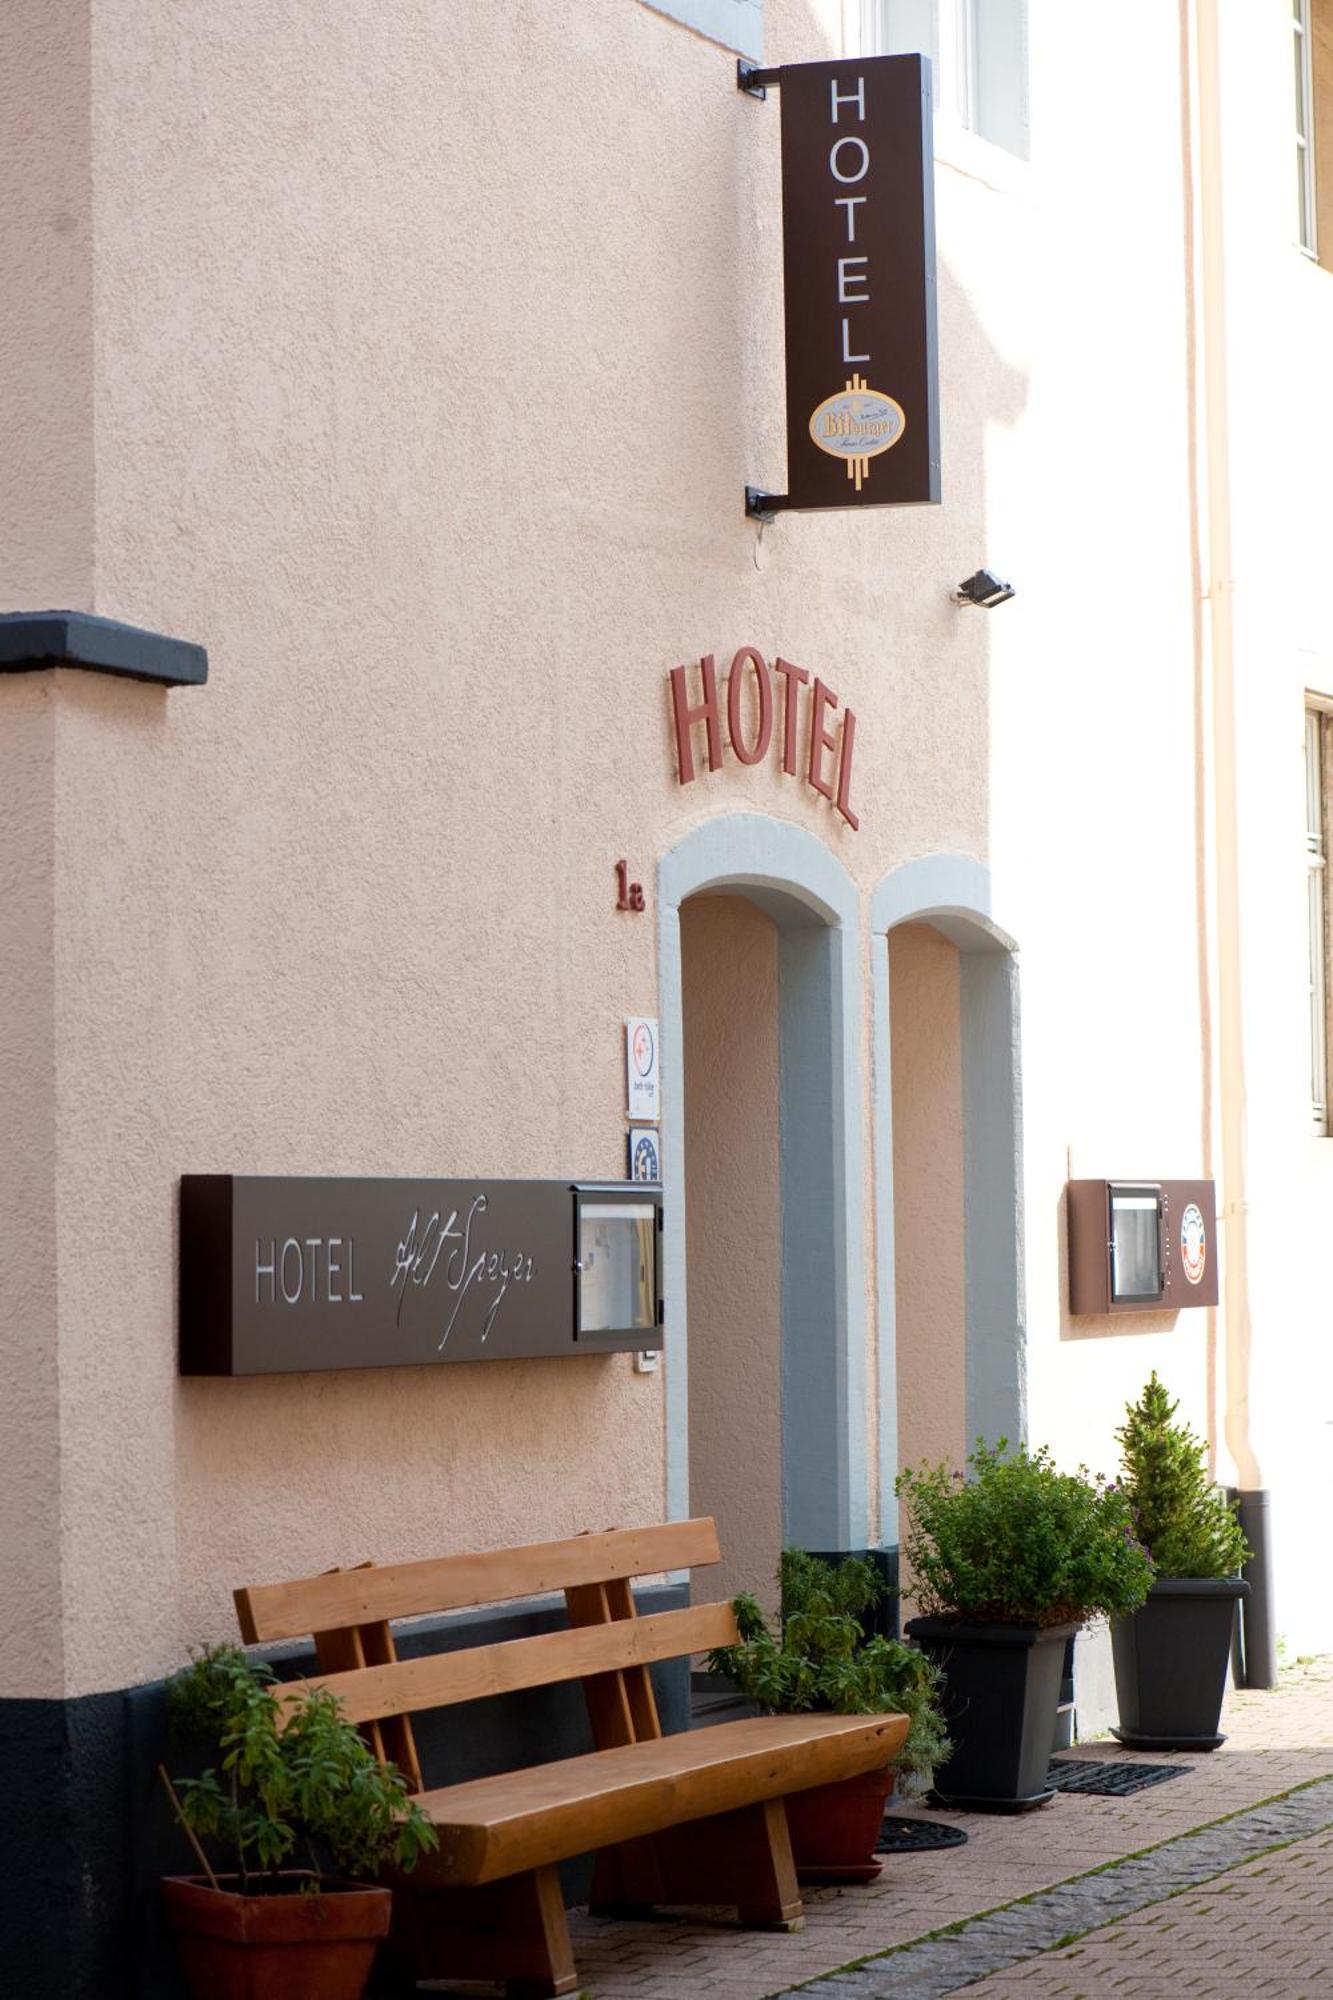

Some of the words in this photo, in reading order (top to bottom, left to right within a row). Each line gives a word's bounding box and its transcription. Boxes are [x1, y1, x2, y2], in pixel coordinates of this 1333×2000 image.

[828, 76, 871, 363] HOTEL
[669, 646, 860, 832] HOTEL
[614, 859, 646, 912] 1a
[254, 1237, 363, 1304] HOTEL
